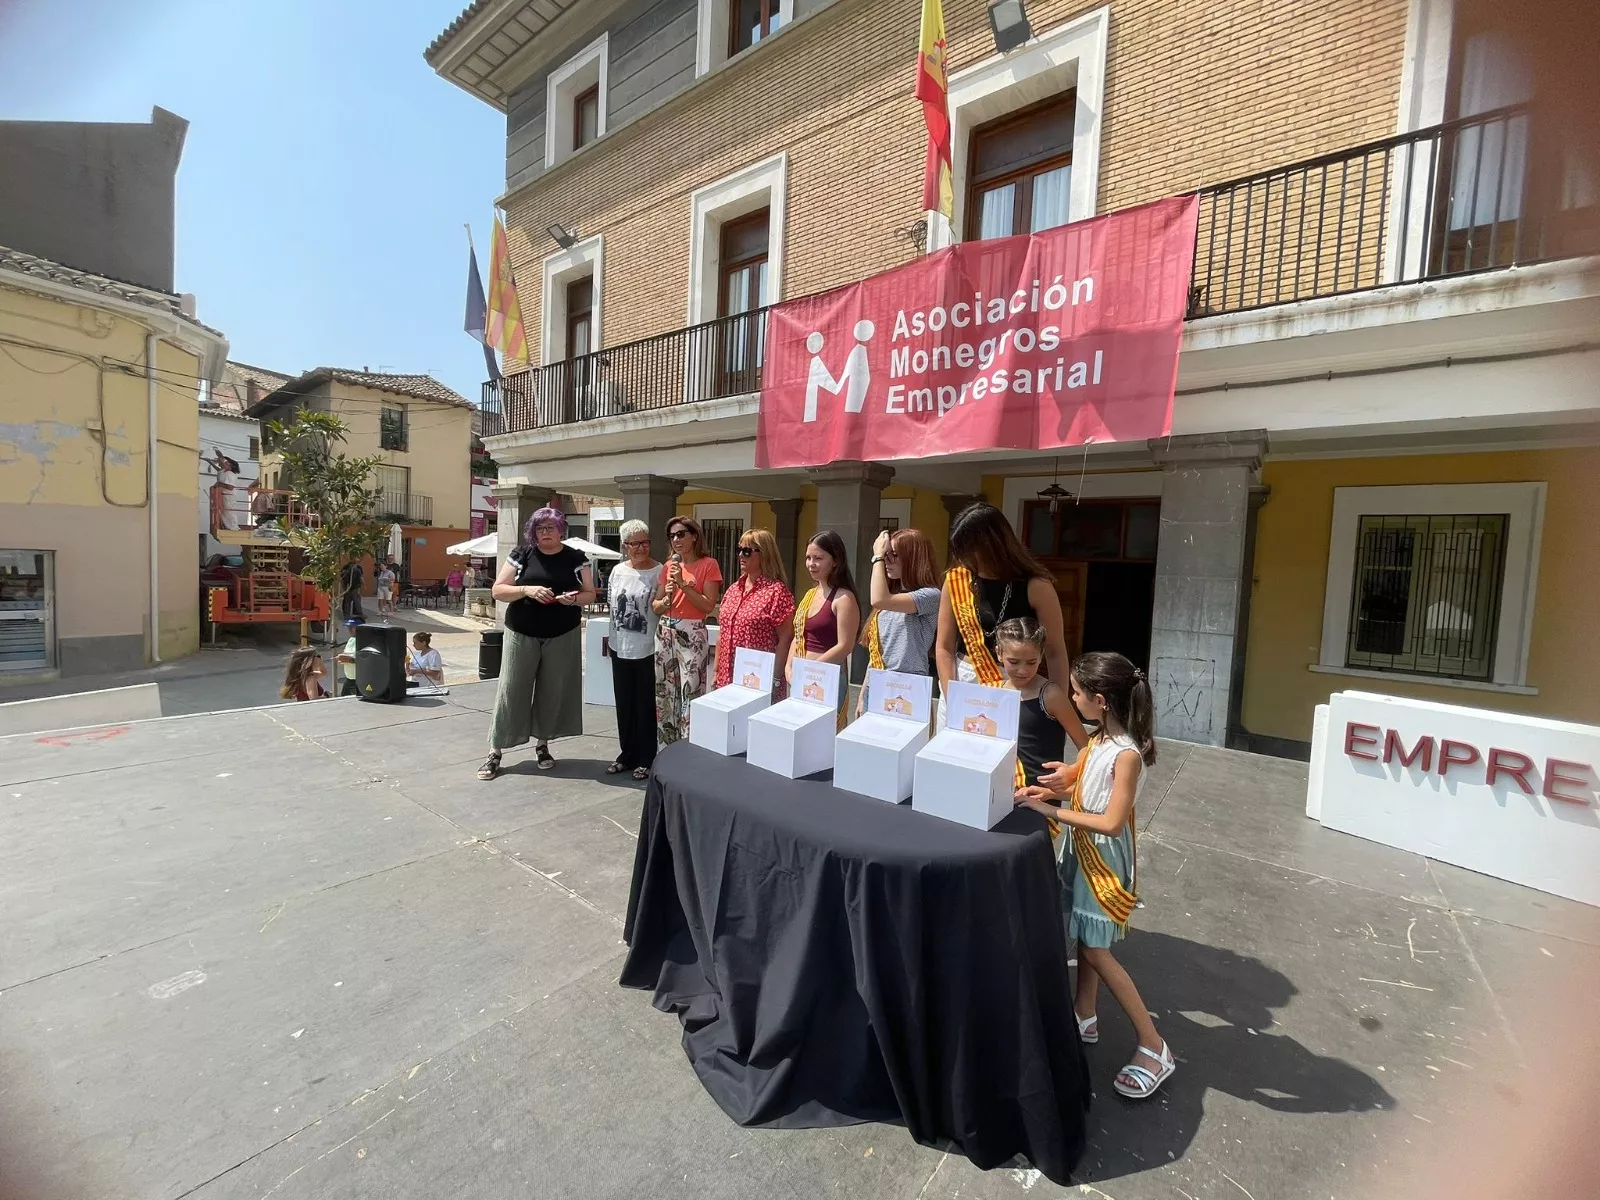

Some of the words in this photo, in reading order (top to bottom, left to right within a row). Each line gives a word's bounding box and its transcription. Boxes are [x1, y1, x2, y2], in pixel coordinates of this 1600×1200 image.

[891, 275, 1095, 342] Asociación
[885, 350, 1104, 417] Empresarial
[889, 325, 1061, 379] Monegros
[1344, 721, 1592, 806] EMPRE
